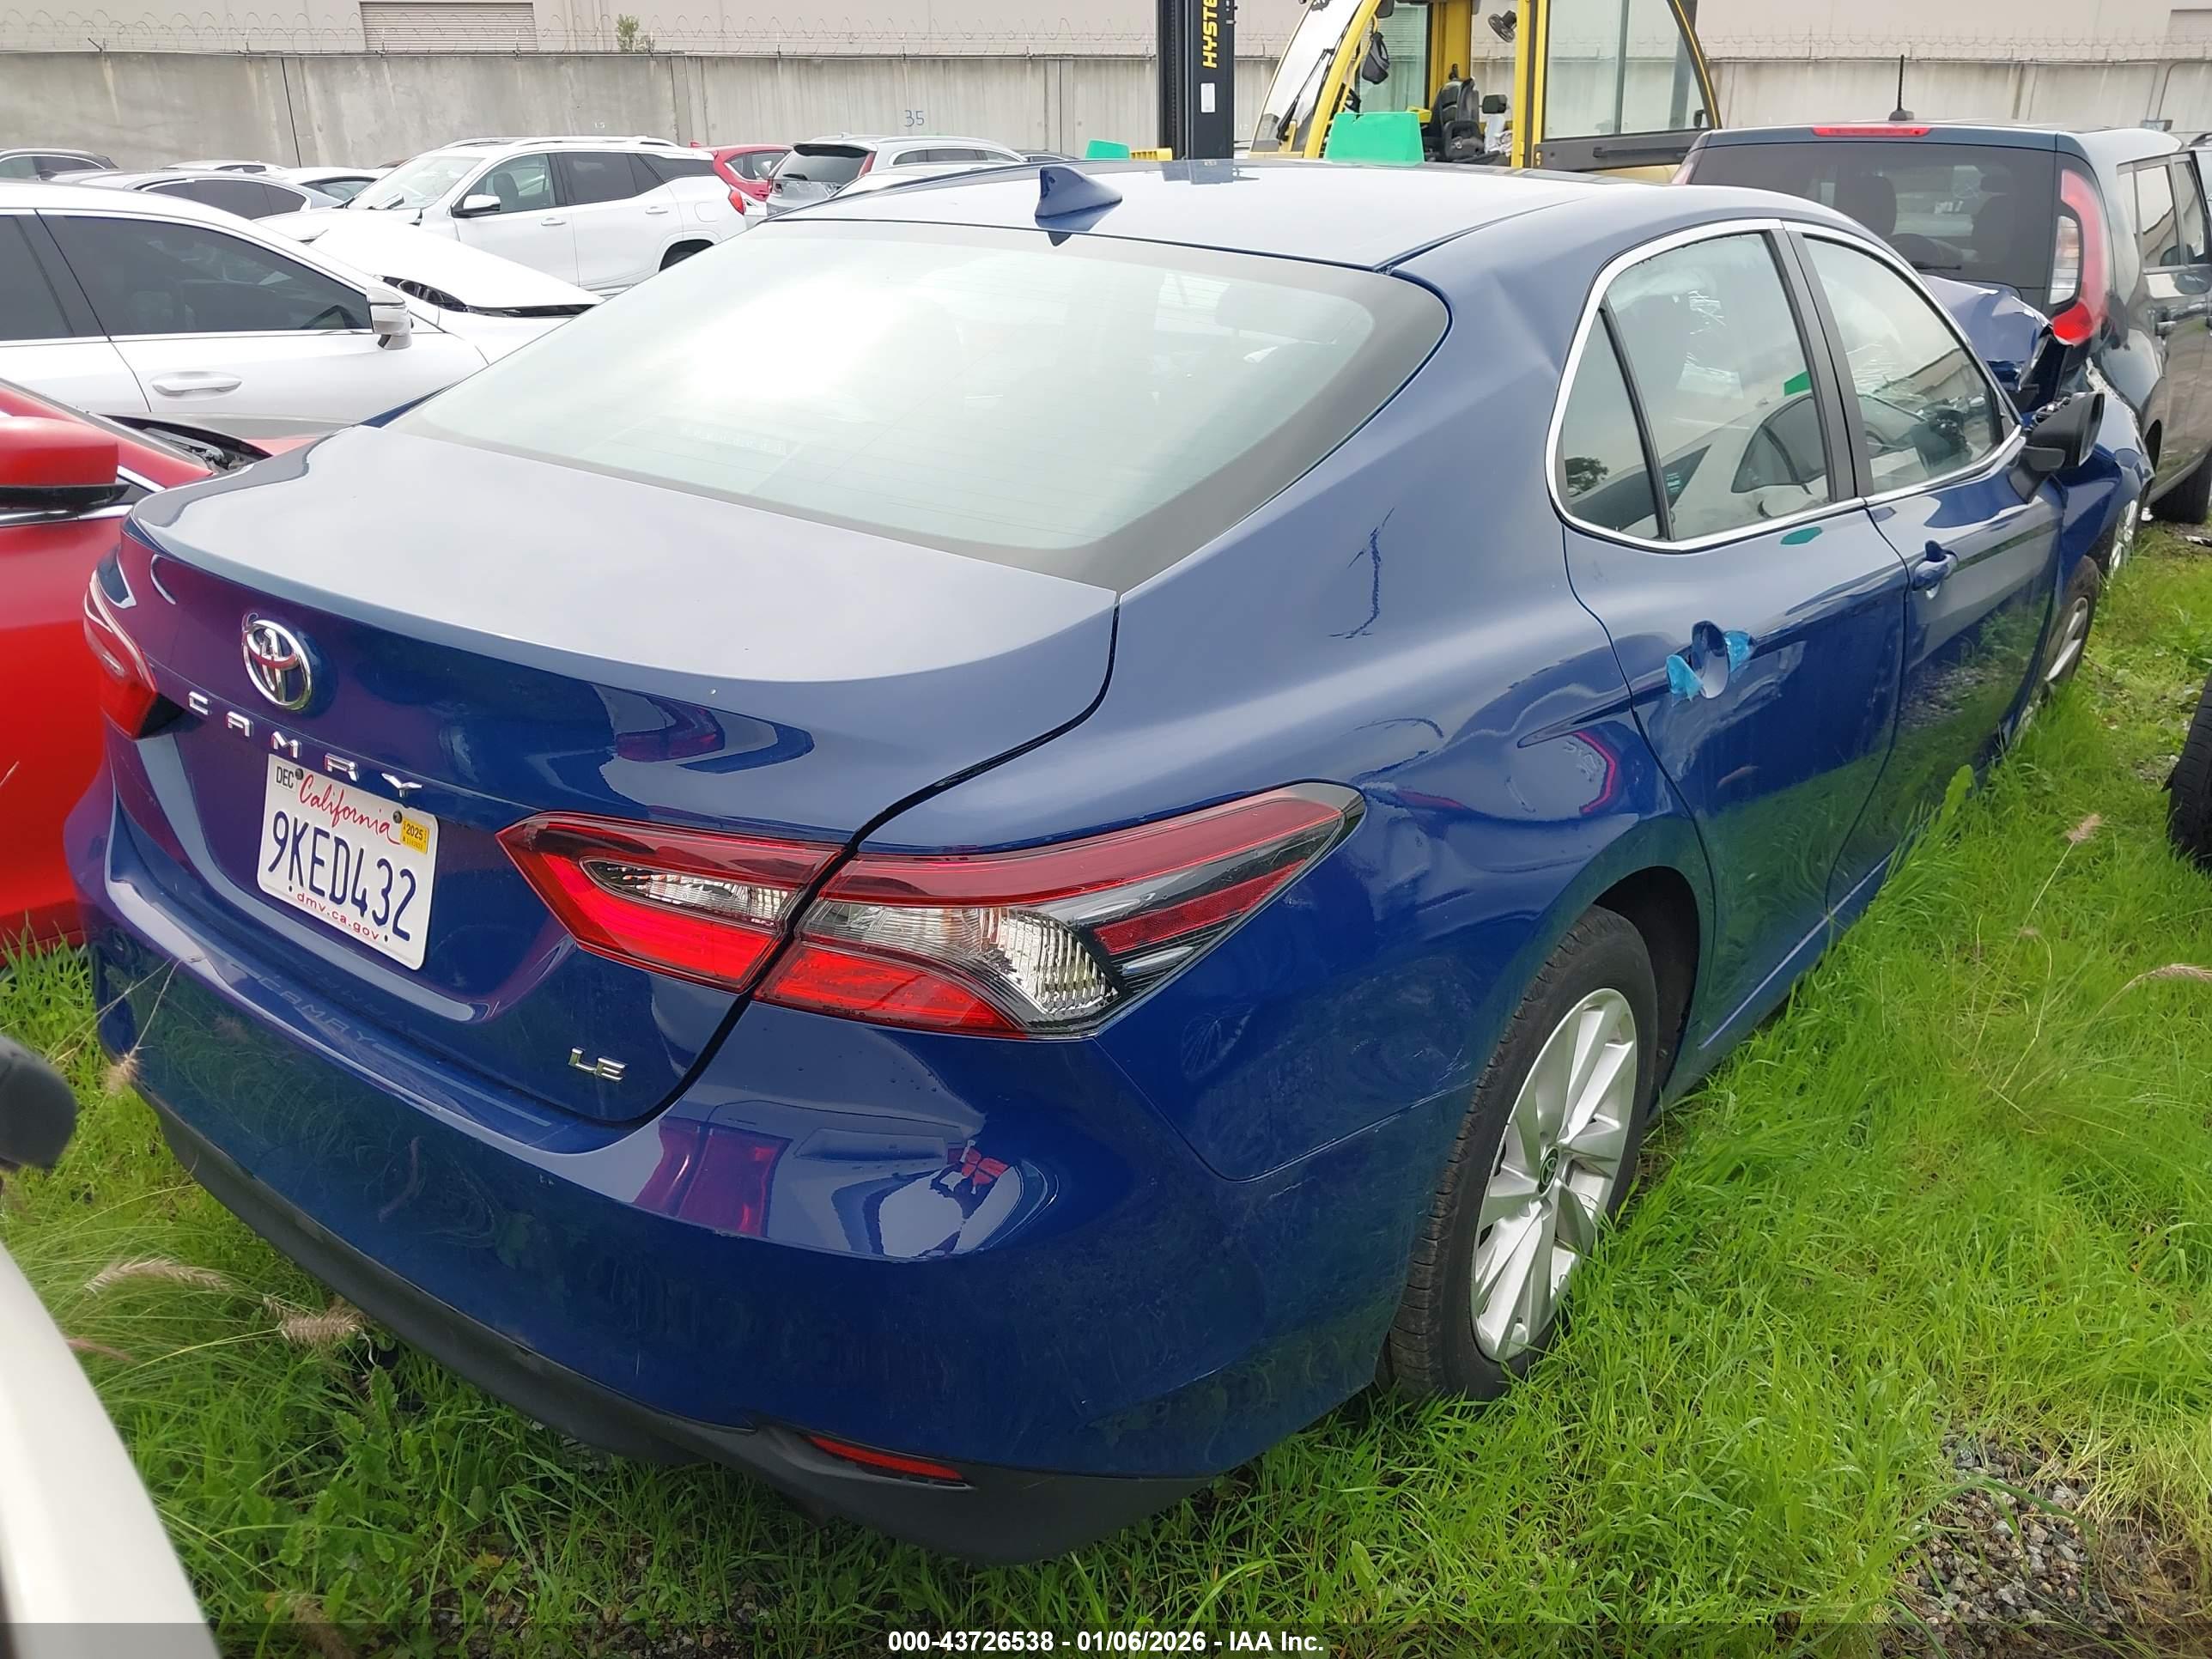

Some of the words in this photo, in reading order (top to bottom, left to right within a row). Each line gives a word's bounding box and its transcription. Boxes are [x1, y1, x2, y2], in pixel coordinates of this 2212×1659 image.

[904, 110, 924, 127] 35
[188, 691, 422, 798] CAMRY
[276, 766, 295, 789] DEC
[300, 774, 401, 845] California
[406, 823, 423, 841] 2025
[268, 811, 416, 941] 9KED432
[296, 892, 380, 940] dmv.ca.gov
[568, 1048, 626, 1082] LE
